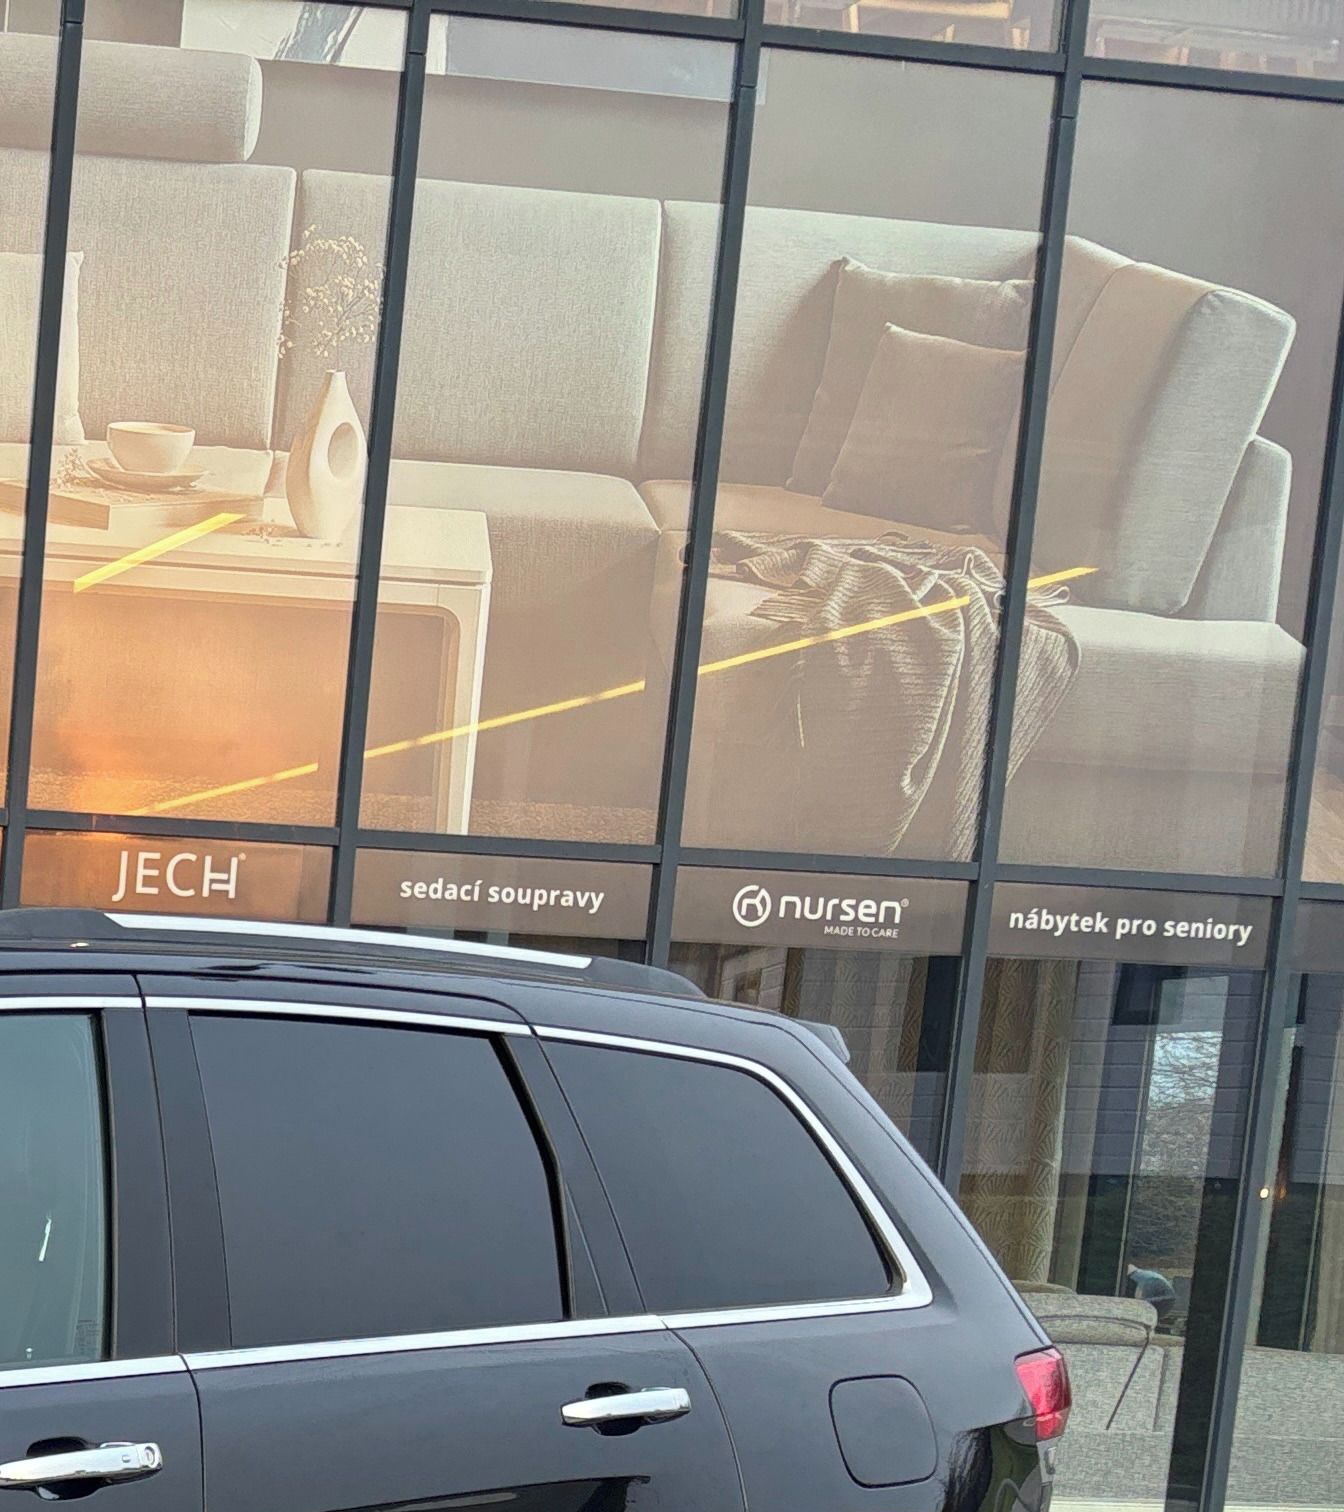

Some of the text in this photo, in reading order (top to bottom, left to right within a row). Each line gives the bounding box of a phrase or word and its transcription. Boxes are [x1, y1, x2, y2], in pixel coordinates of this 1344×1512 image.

[400, 878, 605, 914] sedací soupravy
[824, 925, 899, 938] MADE TO CARE
[1010, 907, 1253, 946] nábytek pro seniory
